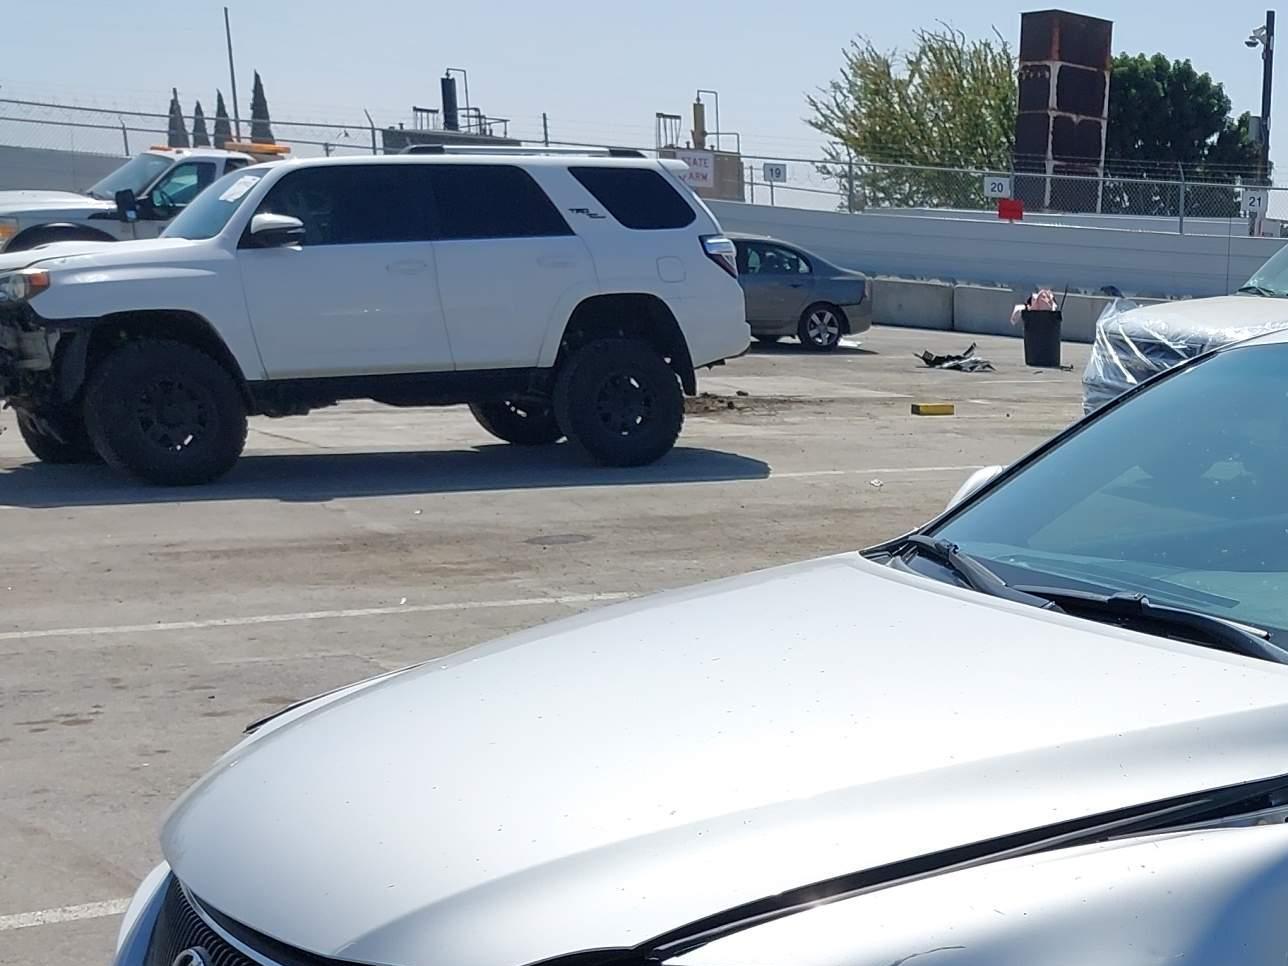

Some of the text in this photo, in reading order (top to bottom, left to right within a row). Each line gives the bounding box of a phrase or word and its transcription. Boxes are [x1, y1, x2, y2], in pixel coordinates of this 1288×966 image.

[769, 167, 781, 178] 19
[990, 182, 1004, 193] 20
[1248, 196, 1262, 207] 21
